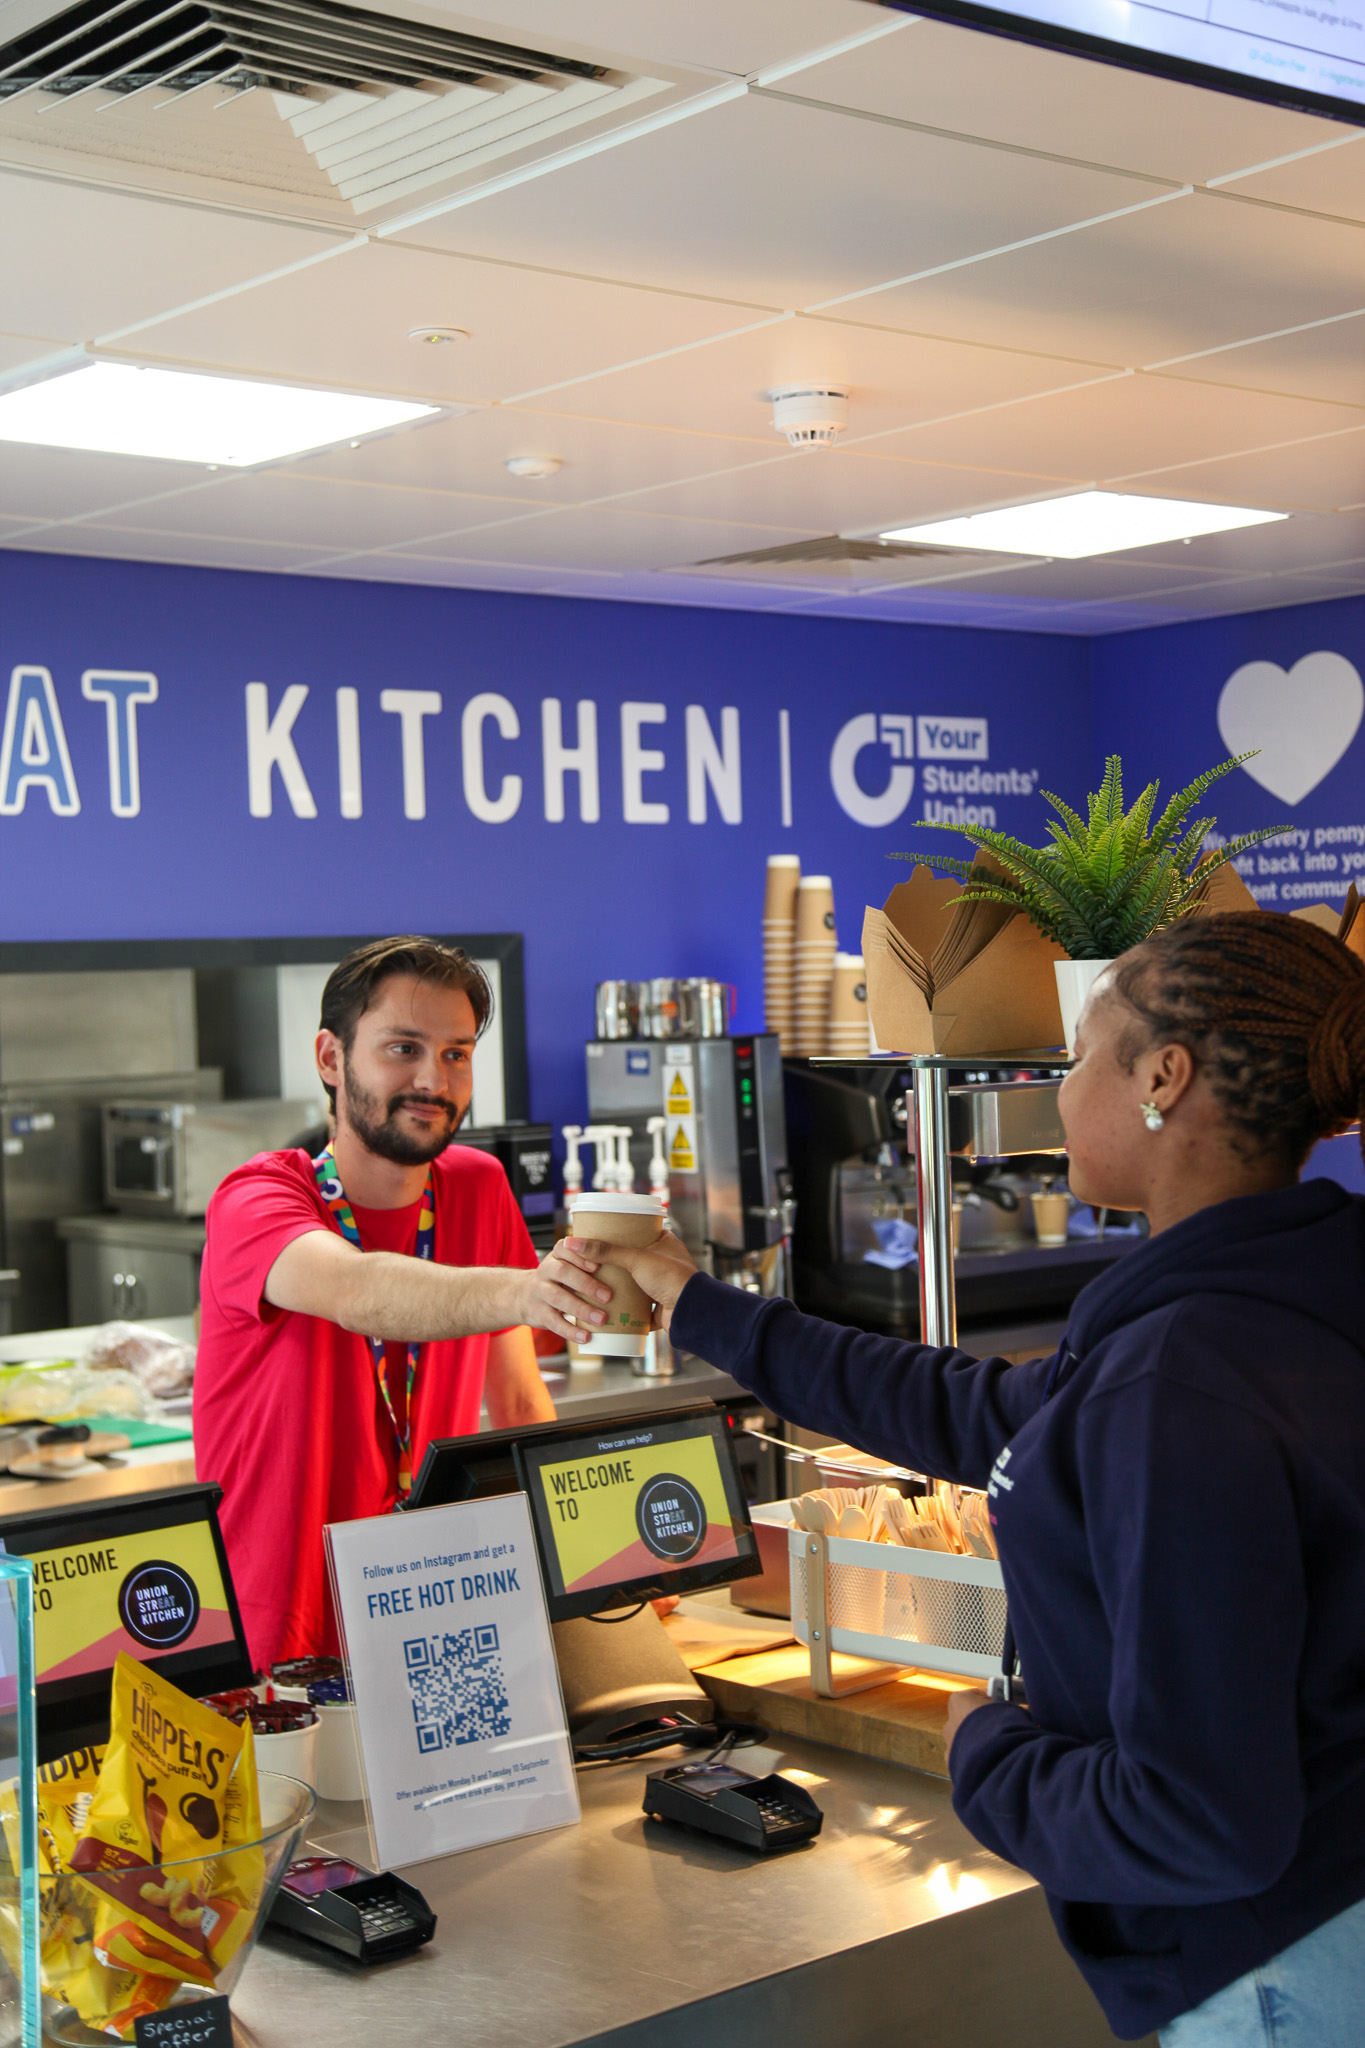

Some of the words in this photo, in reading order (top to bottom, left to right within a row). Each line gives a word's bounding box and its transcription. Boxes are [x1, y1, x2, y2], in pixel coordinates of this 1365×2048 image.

[0, 665, 158, 818] AT
[246, 682, 742, 824] KITCHEN
[925, 723, 981, 750] Your
[923, 765, 1039, 795] Students'
[924, 796, 997, 828] Union
[1262, 829, 1310, 850] every
[1314, 825, 1365, 849] penny
[1258, 852, 1300, 874] back
[1304, 851, 1337, 872] into
[598, 1442, 613, 1450] How
[614, 1440, 626, 1448] can
[635, 1433, 653, 1444] help?
[550, 1460, 634, 1495] WELCOME
[556, 1498, 579, 1521] TO
[651, 1499, 679, 1513] UNION
[653, 1510, 685, 1526] STREAT
[656, 1521, 694, 1538] KITCHEN
[363, 1565, 394, 1579] Follow
[397, 1563, 407, 1574] us
[410, 1560, 421, 1571] on
[424, 1553, 471, 1568] Instagram
[473, 1546, 490, 1559] and
[492, 1543, 507, 1558] get
[510, 1544, 515, 1552] a
[136, 1585, 168, 1600] UNION
[139, 1595, 175, 1613] STREAT
[367, 1587, 414, 1618] FREE
[418, 1579, 455, 1609] HOT
[461, 1568, 520, 1600] DRINK
[141, 1607, 184, 1625] KITCHEN
[167, 1763, 190, 1777] puff
[396, 1791, 411, 1800] Offer
[413, 1784, 438, 1796] available
[448, 1778, 470, 1788] Monday
[477, 1772, 488, 1781] and
[488, 1768, 512, 1778] Tuesday
[520, 1758, 549, 1771] September
[468, 1788, 482, 1798] drink
[484, 1787, 492, 1796] per
[507, 1782, 515, 1790] per
[143, 2010, 215, 2038] Special
